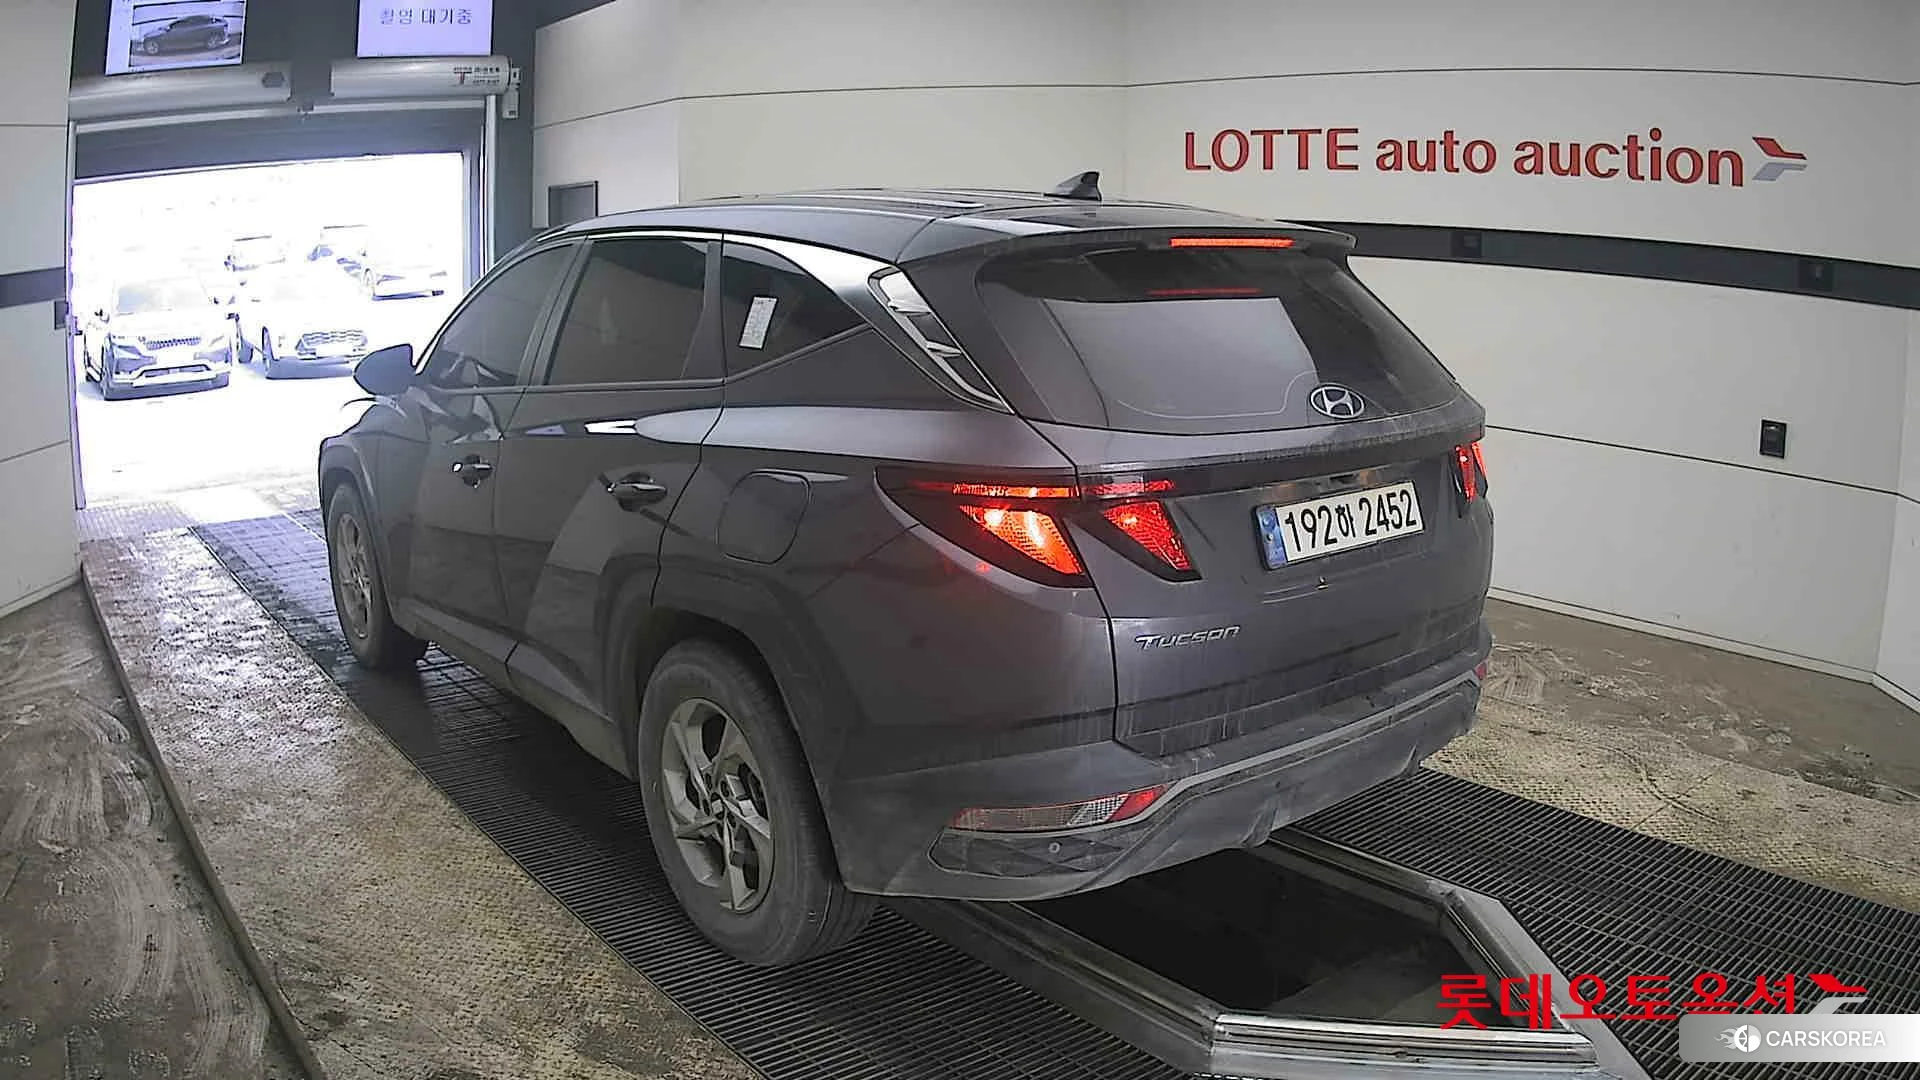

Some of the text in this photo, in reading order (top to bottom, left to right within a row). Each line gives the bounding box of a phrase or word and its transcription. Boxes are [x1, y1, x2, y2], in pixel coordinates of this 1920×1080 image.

[421, 8, 472, 24] 대기중
[1185, 127, 1744, 187] LOTTE auto auction
[1285, 489, 1416, 552] 192하 2452
